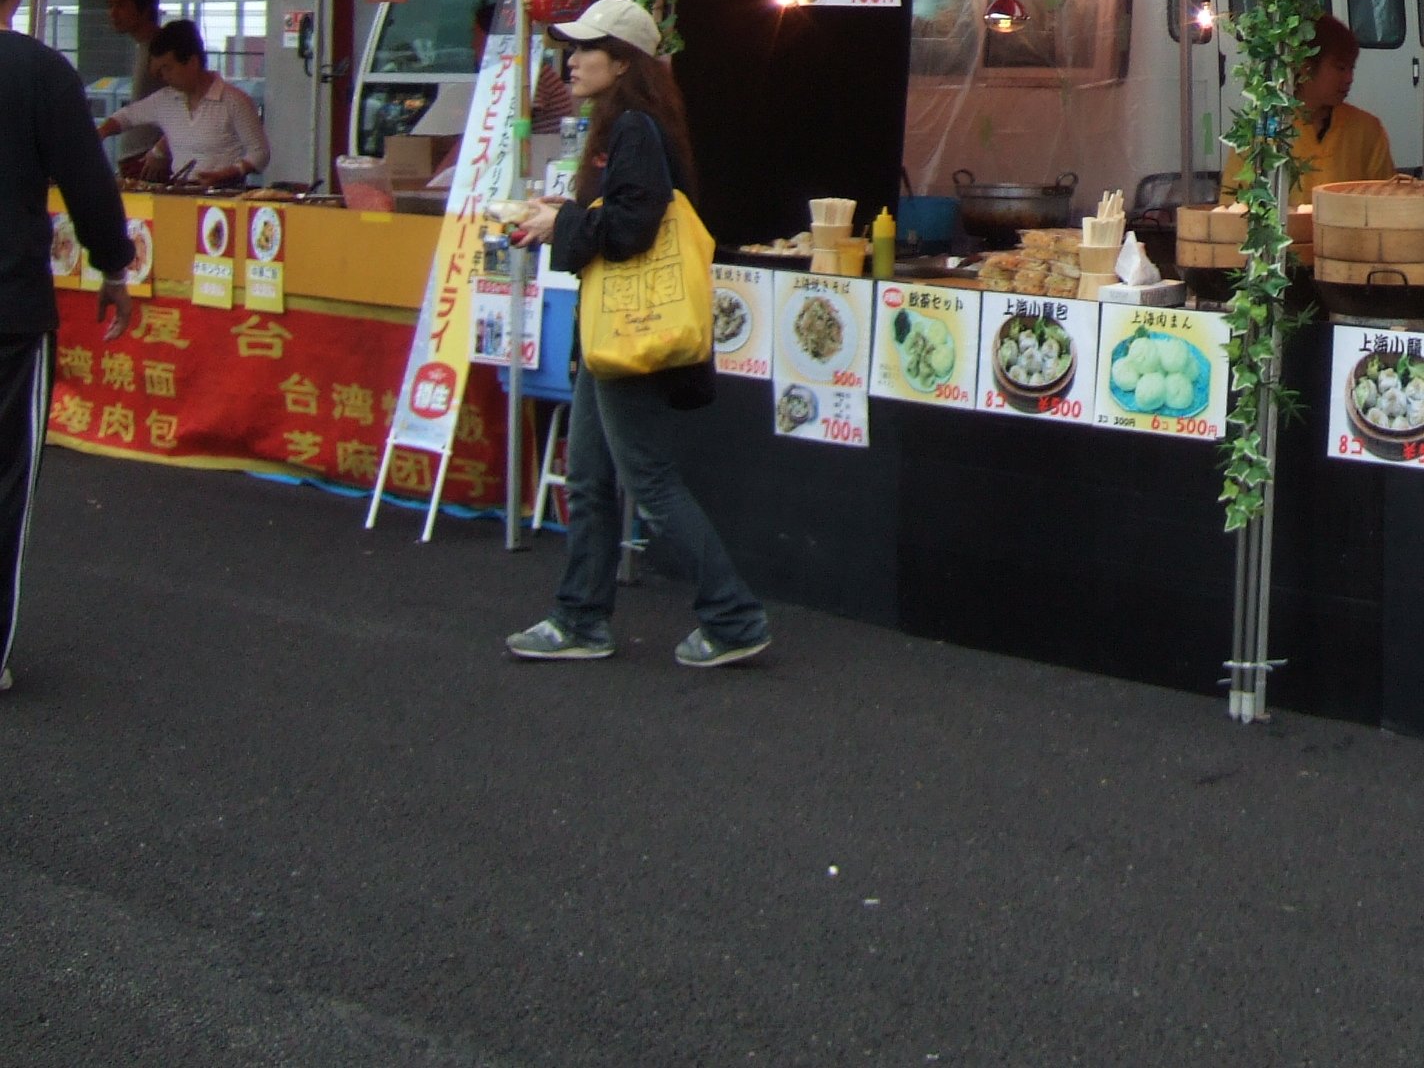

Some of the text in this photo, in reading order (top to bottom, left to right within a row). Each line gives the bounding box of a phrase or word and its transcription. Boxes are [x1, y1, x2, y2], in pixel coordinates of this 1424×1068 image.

[1130, 310, 1192, 329] 上海肉まん
[935, 383, 969, 402] 500円
[1036, 397, 1082, 418] ¥500
[1175, 415, 1218, 436] 500円
[1338, 434, 1365, 456] 8コ
